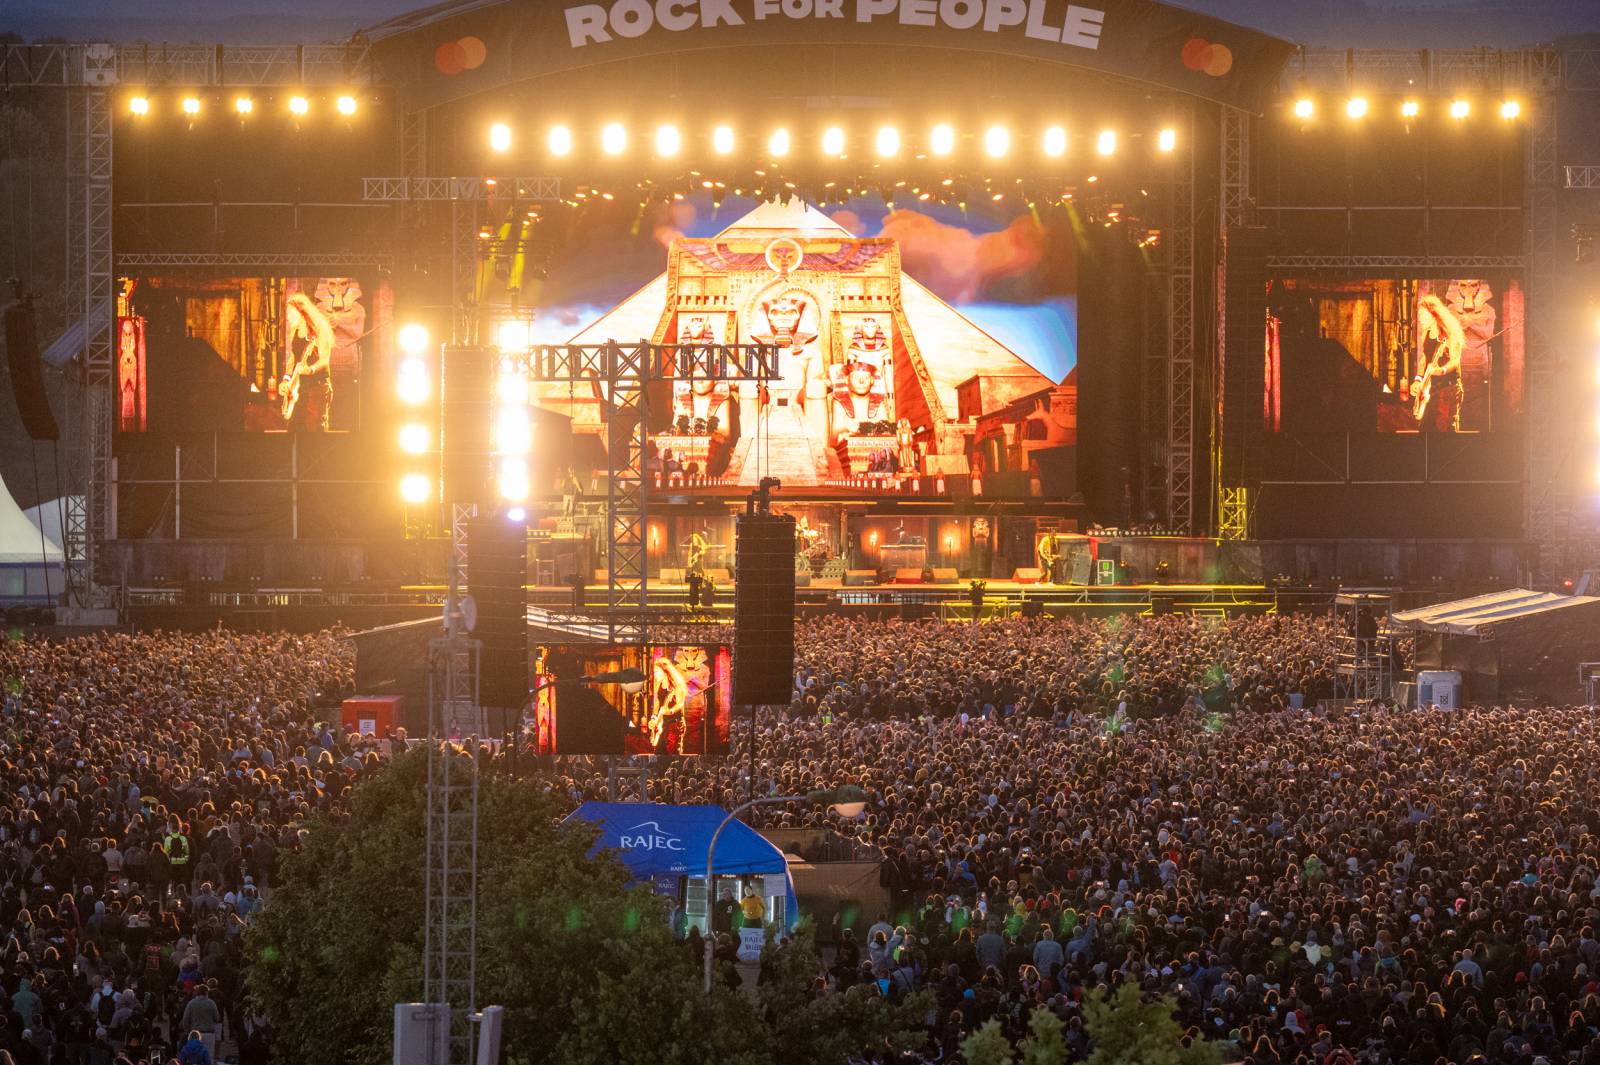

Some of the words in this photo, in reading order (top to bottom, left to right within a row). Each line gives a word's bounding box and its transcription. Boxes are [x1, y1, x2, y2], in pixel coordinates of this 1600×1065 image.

[564, 0, 746, 48] ROCK
[753, 0, 845, 20] FOR
[856, 0, 1105, 50] PEOPLE
